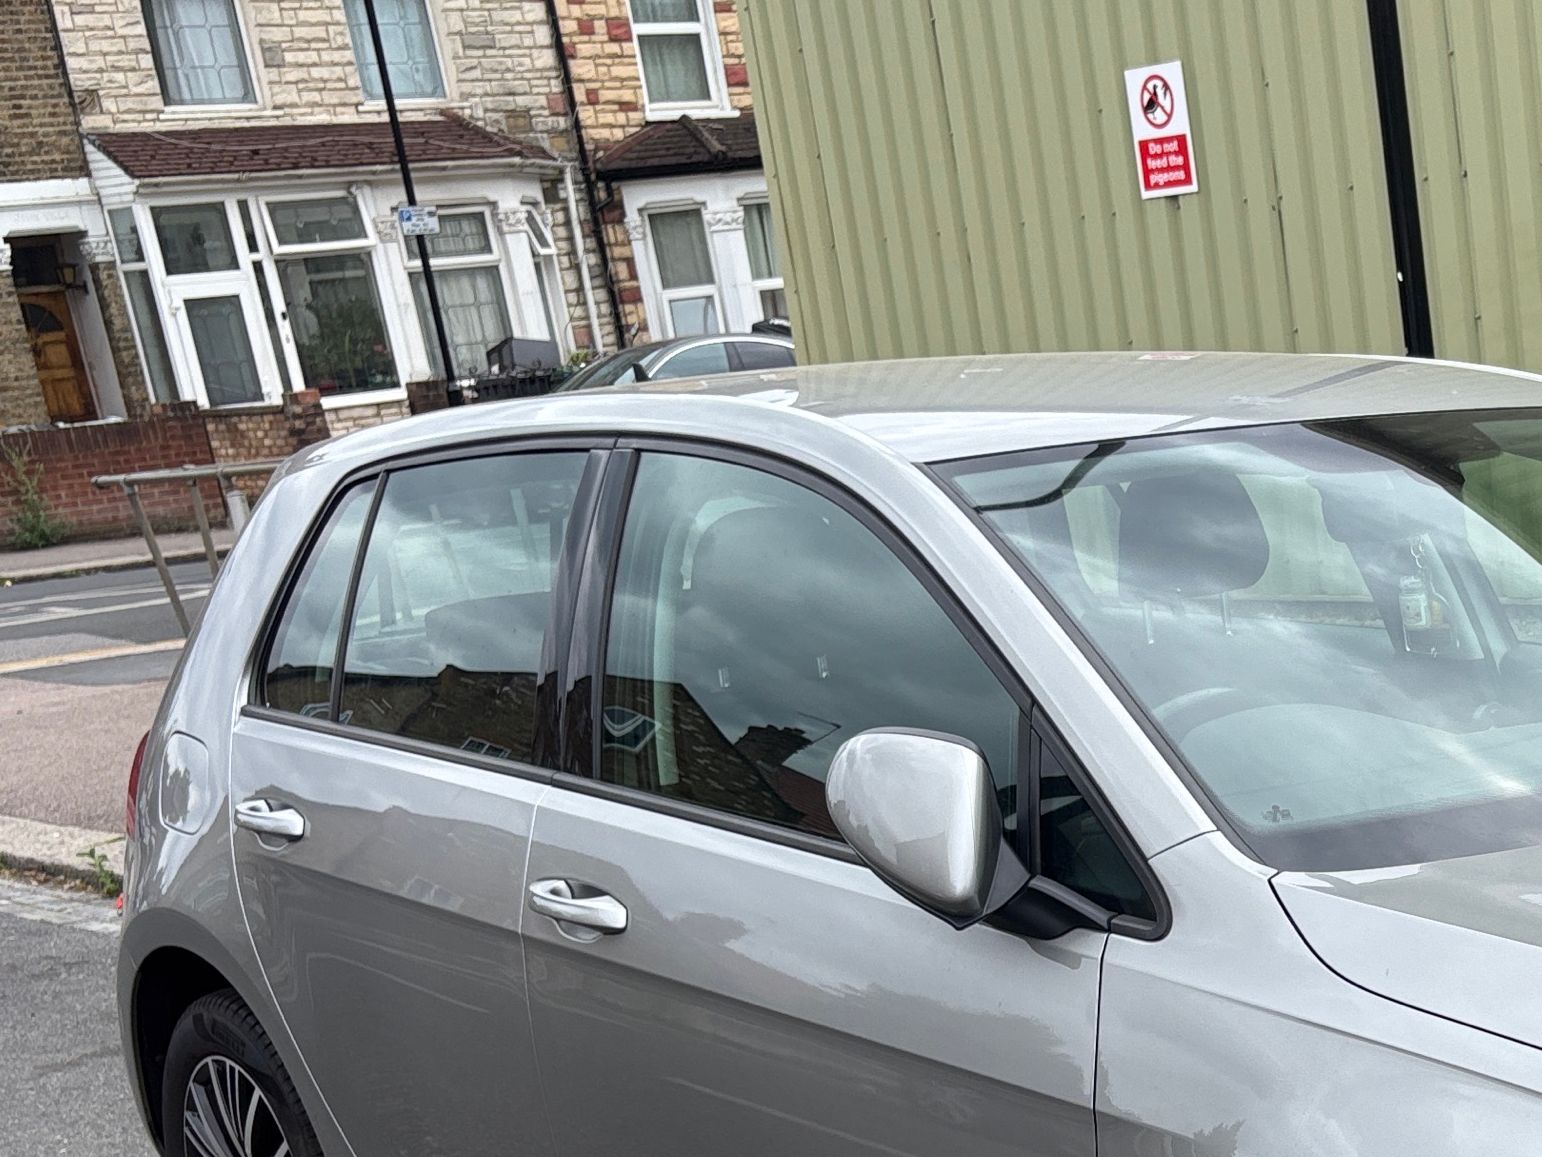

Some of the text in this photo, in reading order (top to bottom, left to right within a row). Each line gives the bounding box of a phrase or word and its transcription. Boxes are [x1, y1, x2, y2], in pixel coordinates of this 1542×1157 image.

[1148, 139, 1178, 154] Do not
[1147, 155, 1184, 170] feed the
[1149, 170, 1185, 187] pigeons
